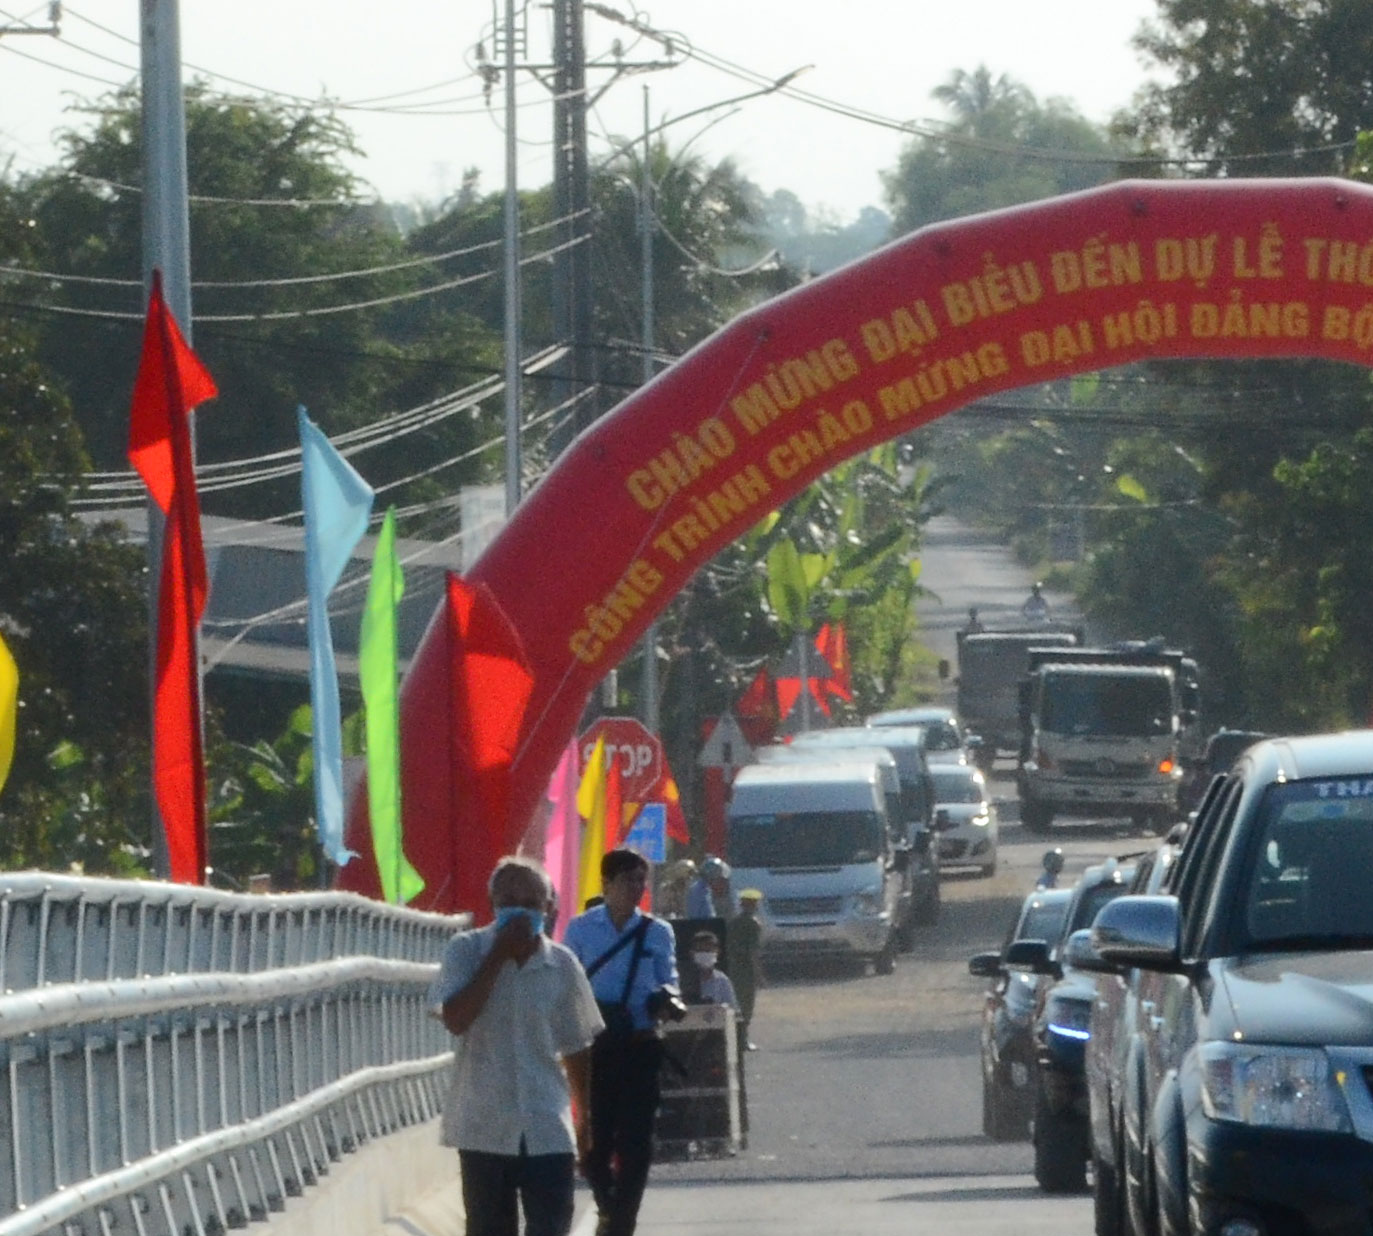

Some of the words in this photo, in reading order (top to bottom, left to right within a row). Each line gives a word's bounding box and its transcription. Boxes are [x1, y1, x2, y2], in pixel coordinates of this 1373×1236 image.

[1050, 231, 1142, 294] ĐẾN
[1154, 233, 1218, 288] DỰ
[568, 559, 663, 663] CÔNG
[1191, 288, 1310, 338] ĐẢNG
